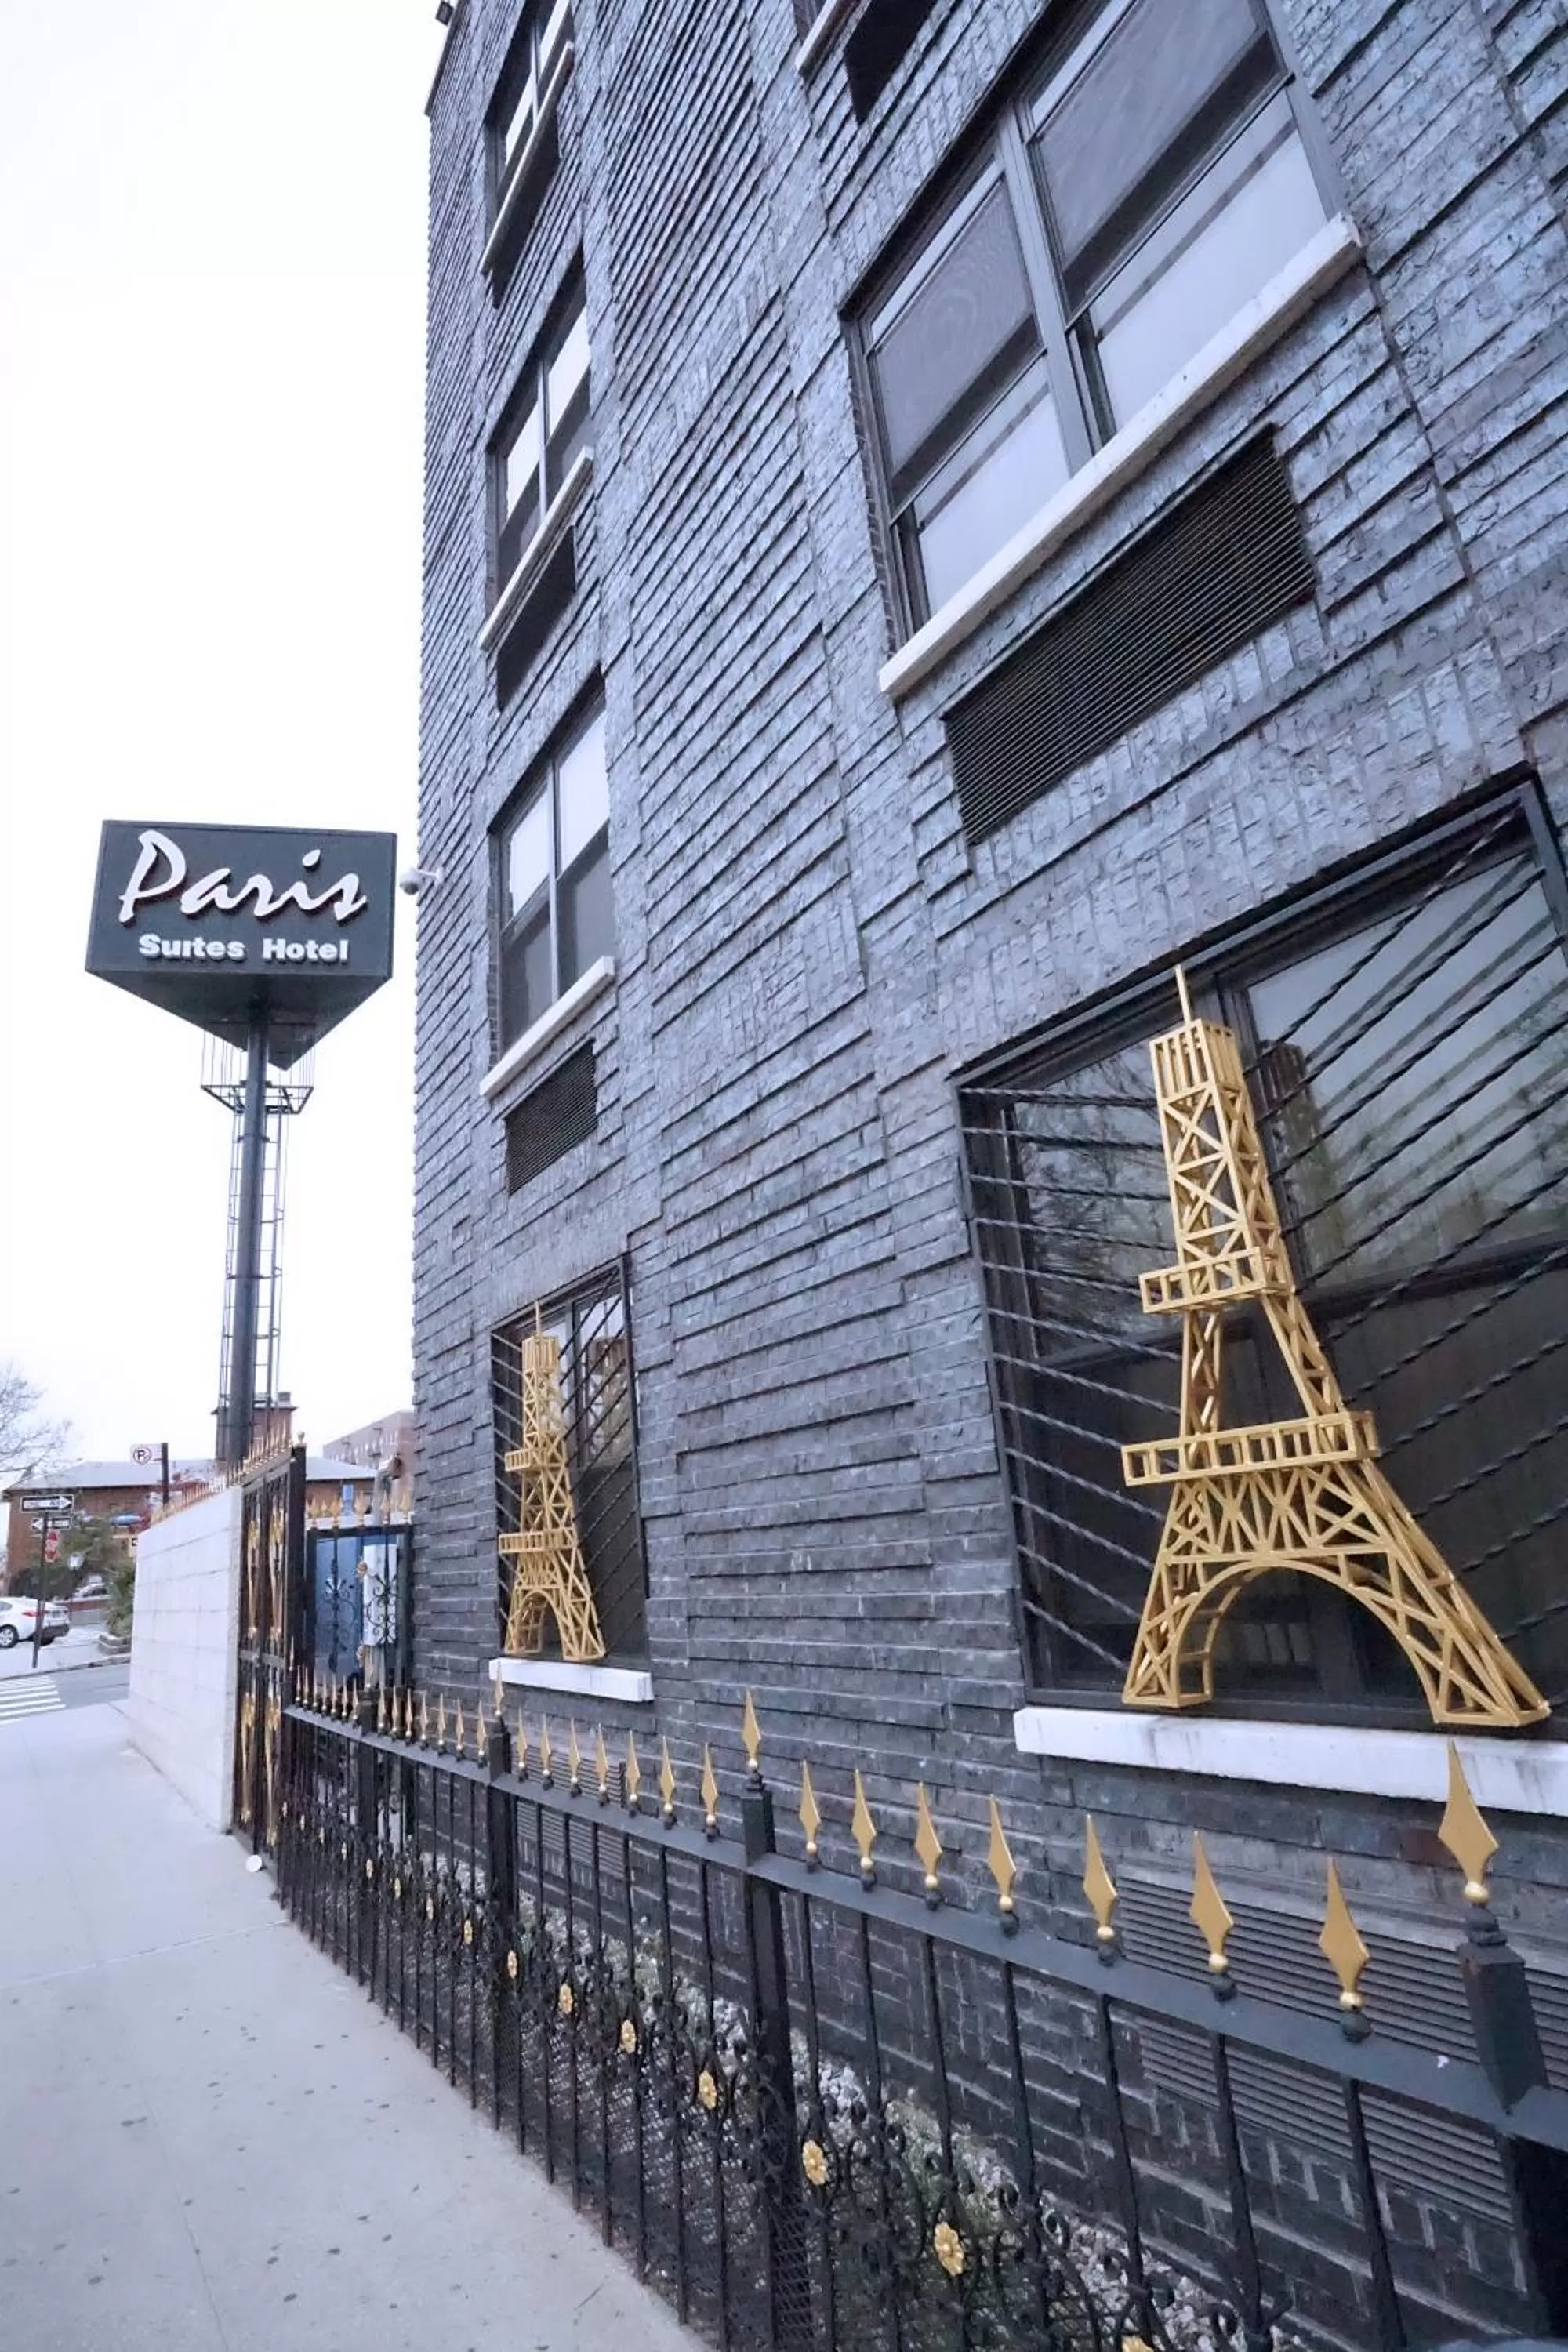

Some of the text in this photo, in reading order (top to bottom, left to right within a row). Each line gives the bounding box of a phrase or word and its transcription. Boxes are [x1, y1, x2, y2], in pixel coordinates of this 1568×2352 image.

[118, 829, 367, 923] Paris
[139, 934, 349, 960] Suites Hotel
